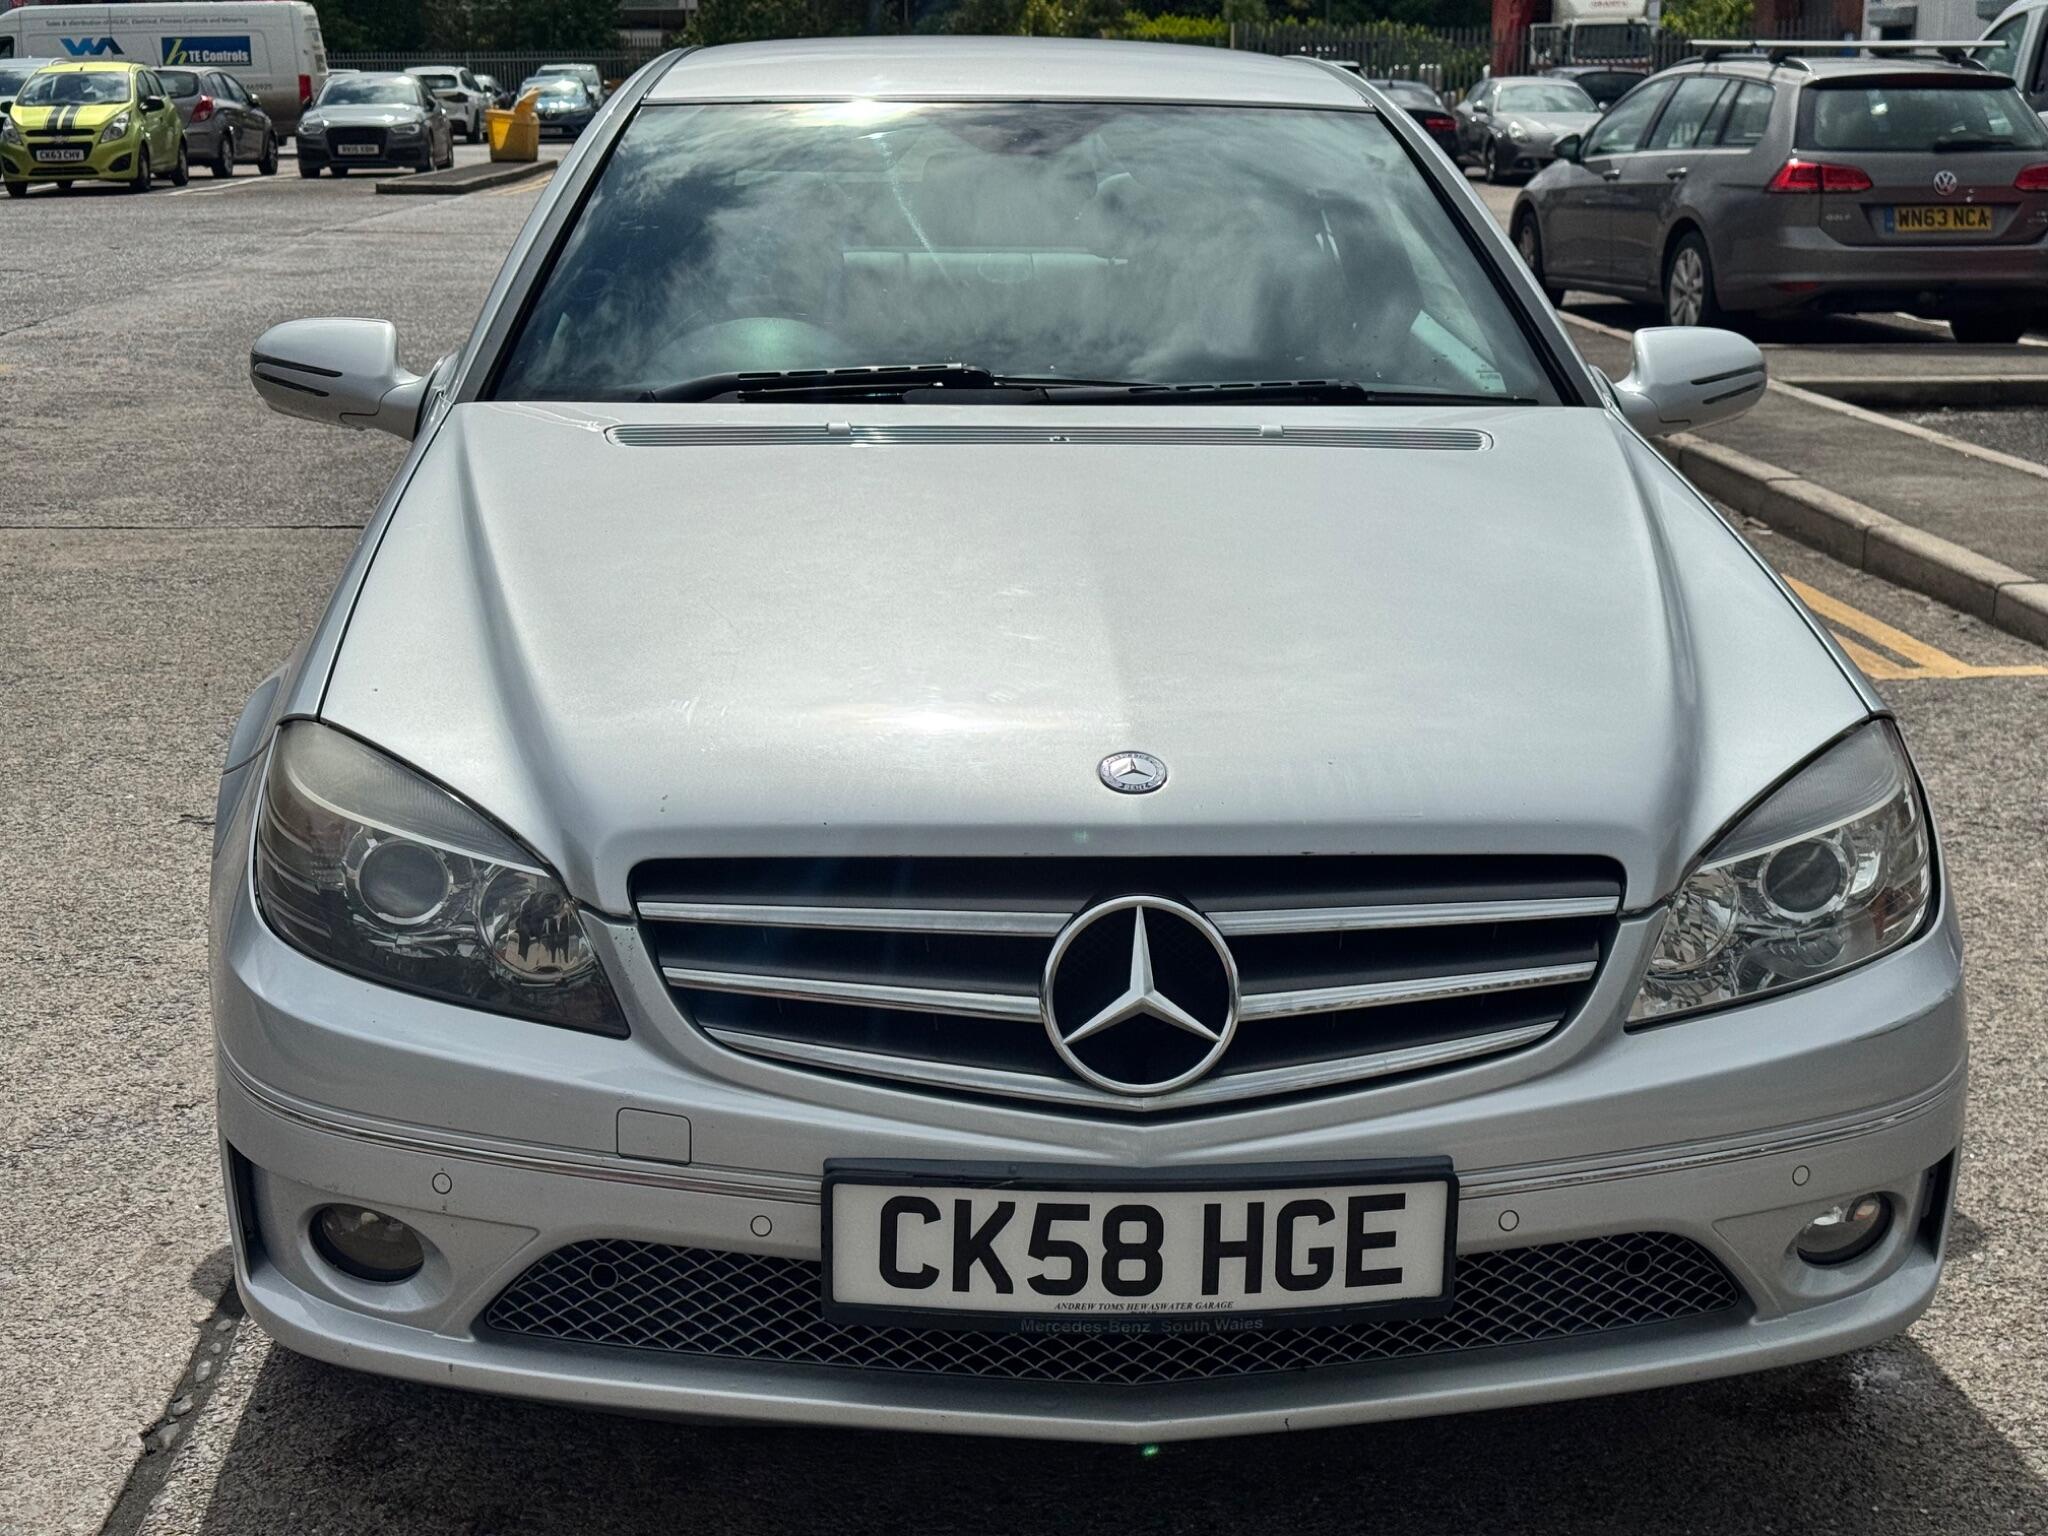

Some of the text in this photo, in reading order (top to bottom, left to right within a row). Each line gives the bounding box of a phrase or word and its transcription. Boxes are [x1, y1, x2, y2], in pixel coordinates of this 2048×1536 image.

[203, 50, 249, 62] Controls
[1899, 208, 1988, 227] WN63 NCA
[879, 1193, 1406, 1296] CK58 HGE
[1054, 1303, 1097, 1311] ANDREW
[1099, 1303, 1125, 1311] TOMS
[1195, 1301, 1234, 1310] GARAGE
[1020, 1318, 1264, 1333] Mercedes-Benz South Wales
